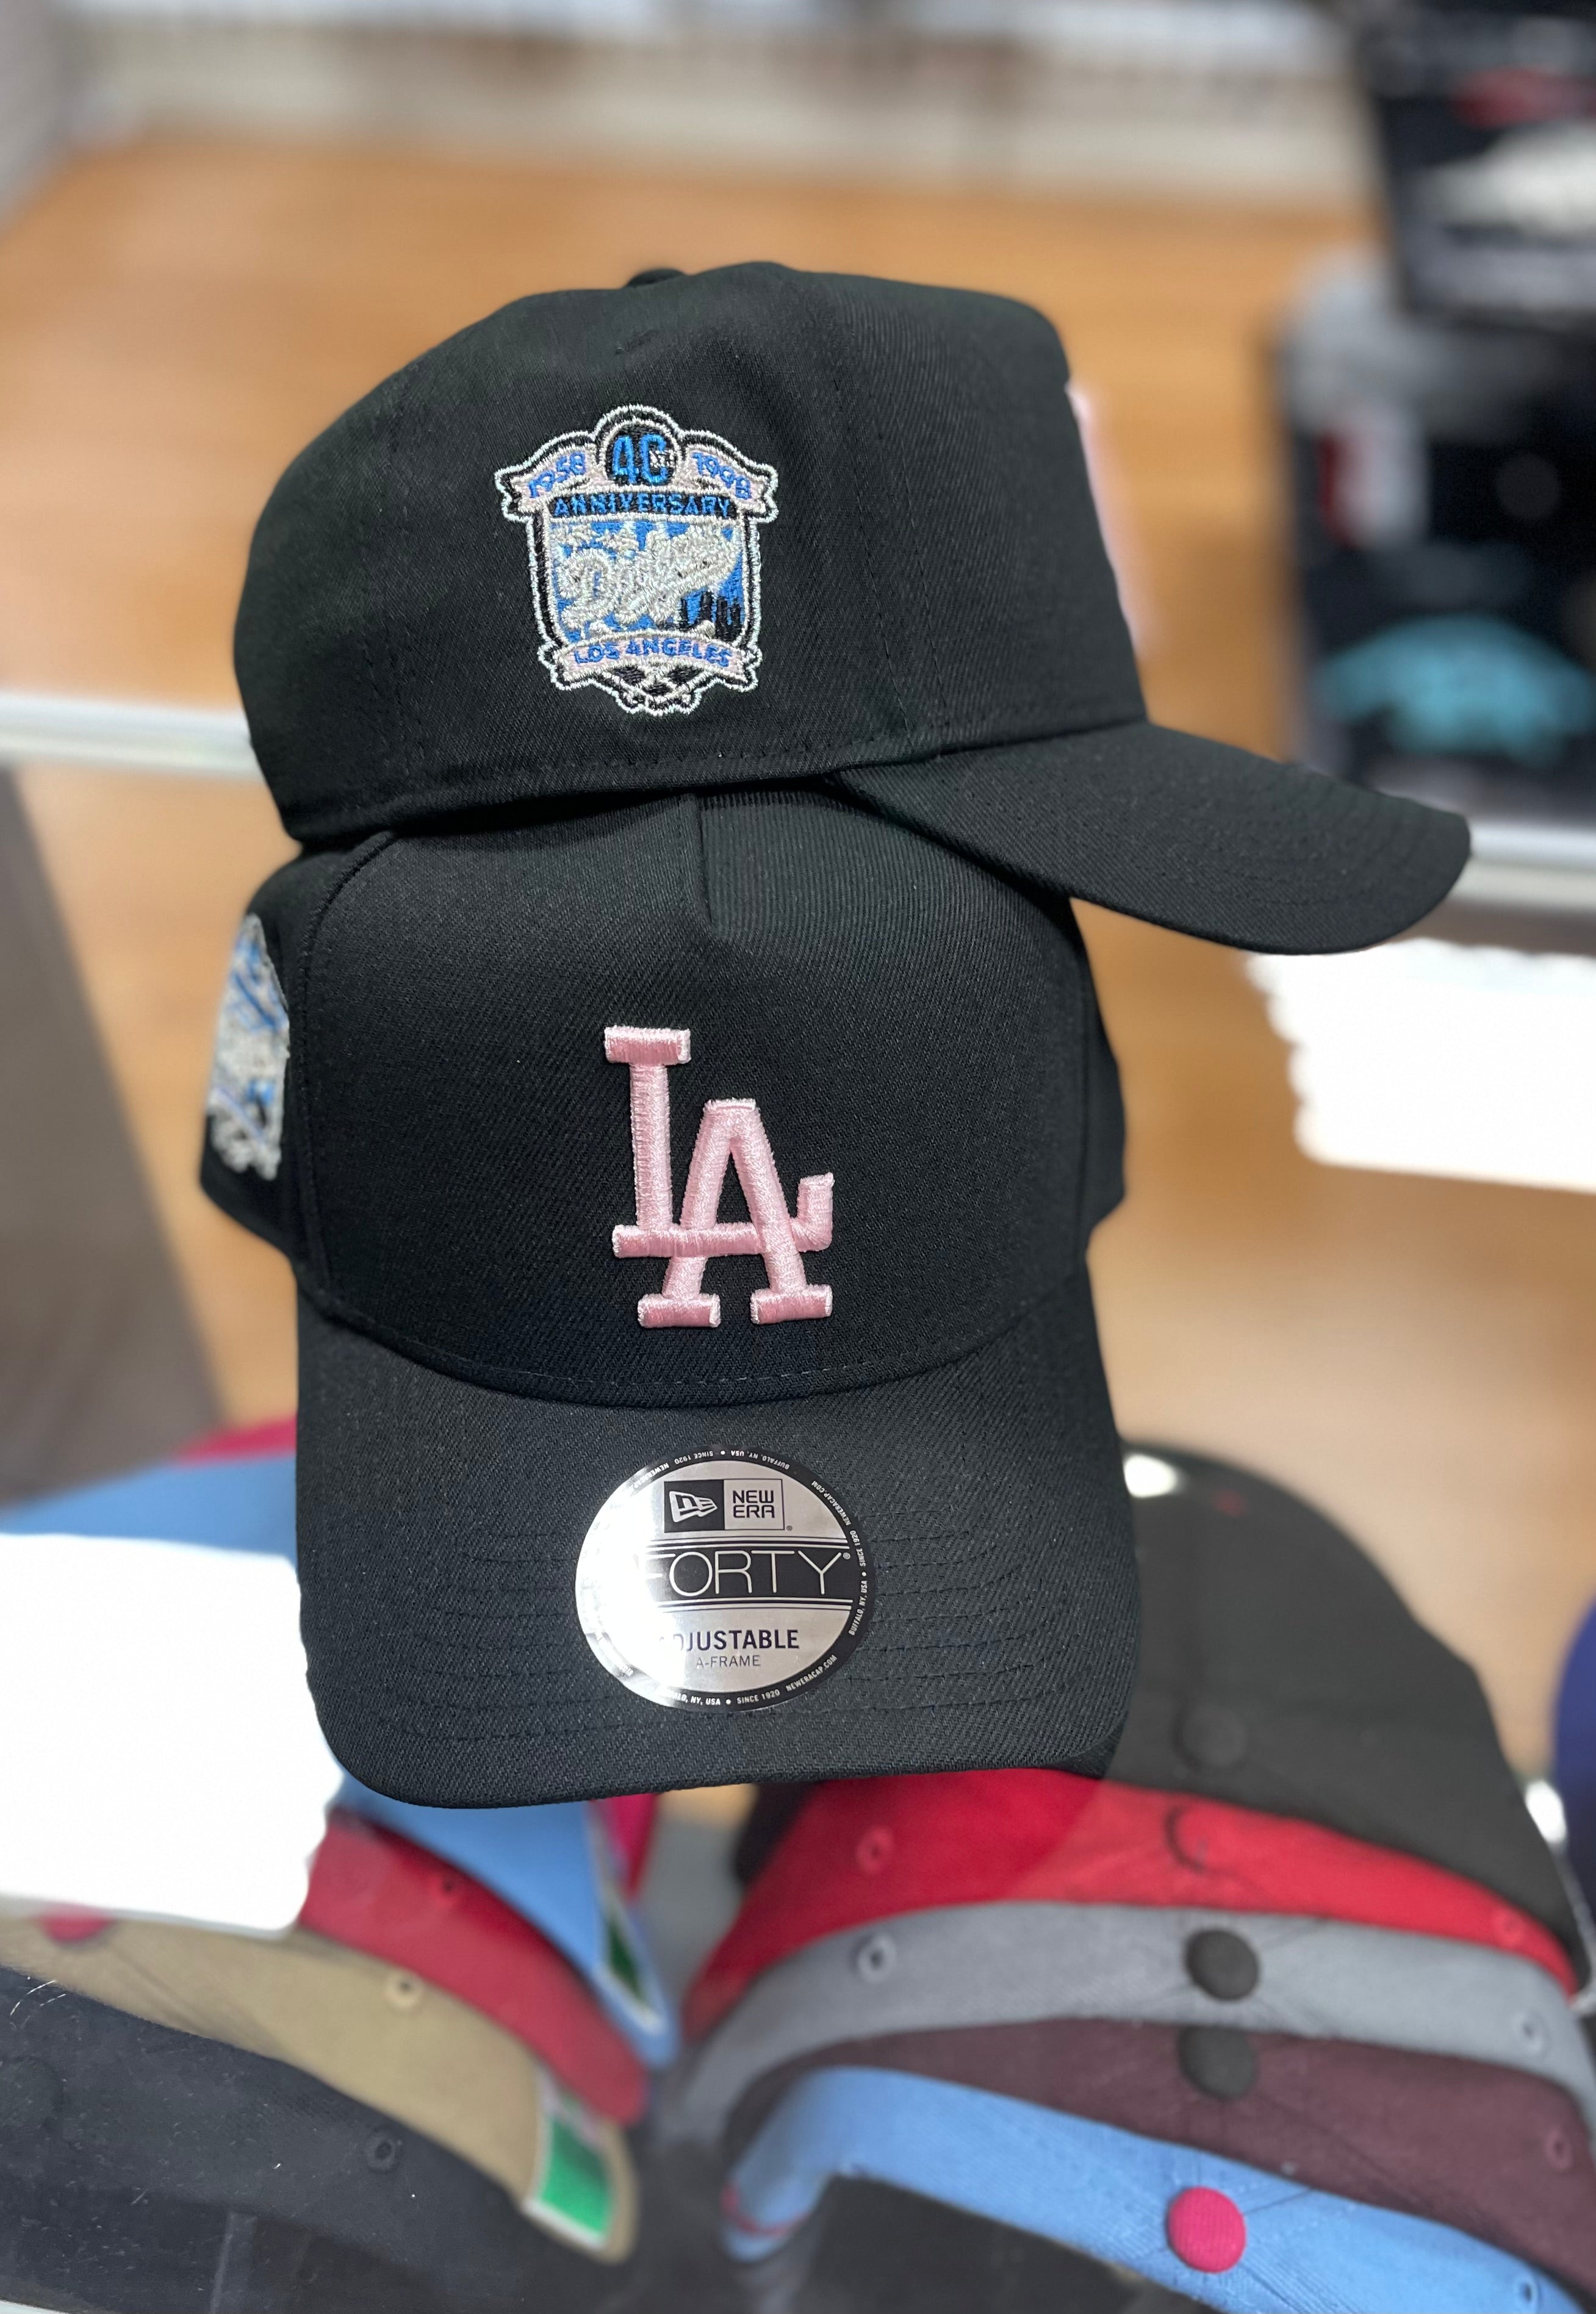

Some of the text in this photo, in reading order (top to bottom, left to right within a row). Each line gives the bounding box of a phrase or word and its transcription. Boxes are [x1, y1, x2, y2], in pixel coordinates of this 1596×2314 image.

[528, 451, 587, 499] 1958
[692, 451, 752, 500] 1998
[553, 492, 730, 518] ANNIVERSARY
[573, 637, 733, 668] LOS ANGELES
[604, 1025, 835, 1329] LA
[674, 1455, 691, 1464] 1920
[732, 1490, 775, 1504] NEW
[733, 1504, 775, 1518] ERA
[811, 1481, 851, 1525] NEWERACAP.COM
[850, 1530, 866, 1567] SINCE 1920
[660, 1630, 800, 1651] DJUSTABLE
[696, 1655, 761, 1669] A-FRAME
[785, 1655, 838, 1692] NEWERACAP.COM
[736, 1689, 780, 1705] SINCE 1920
